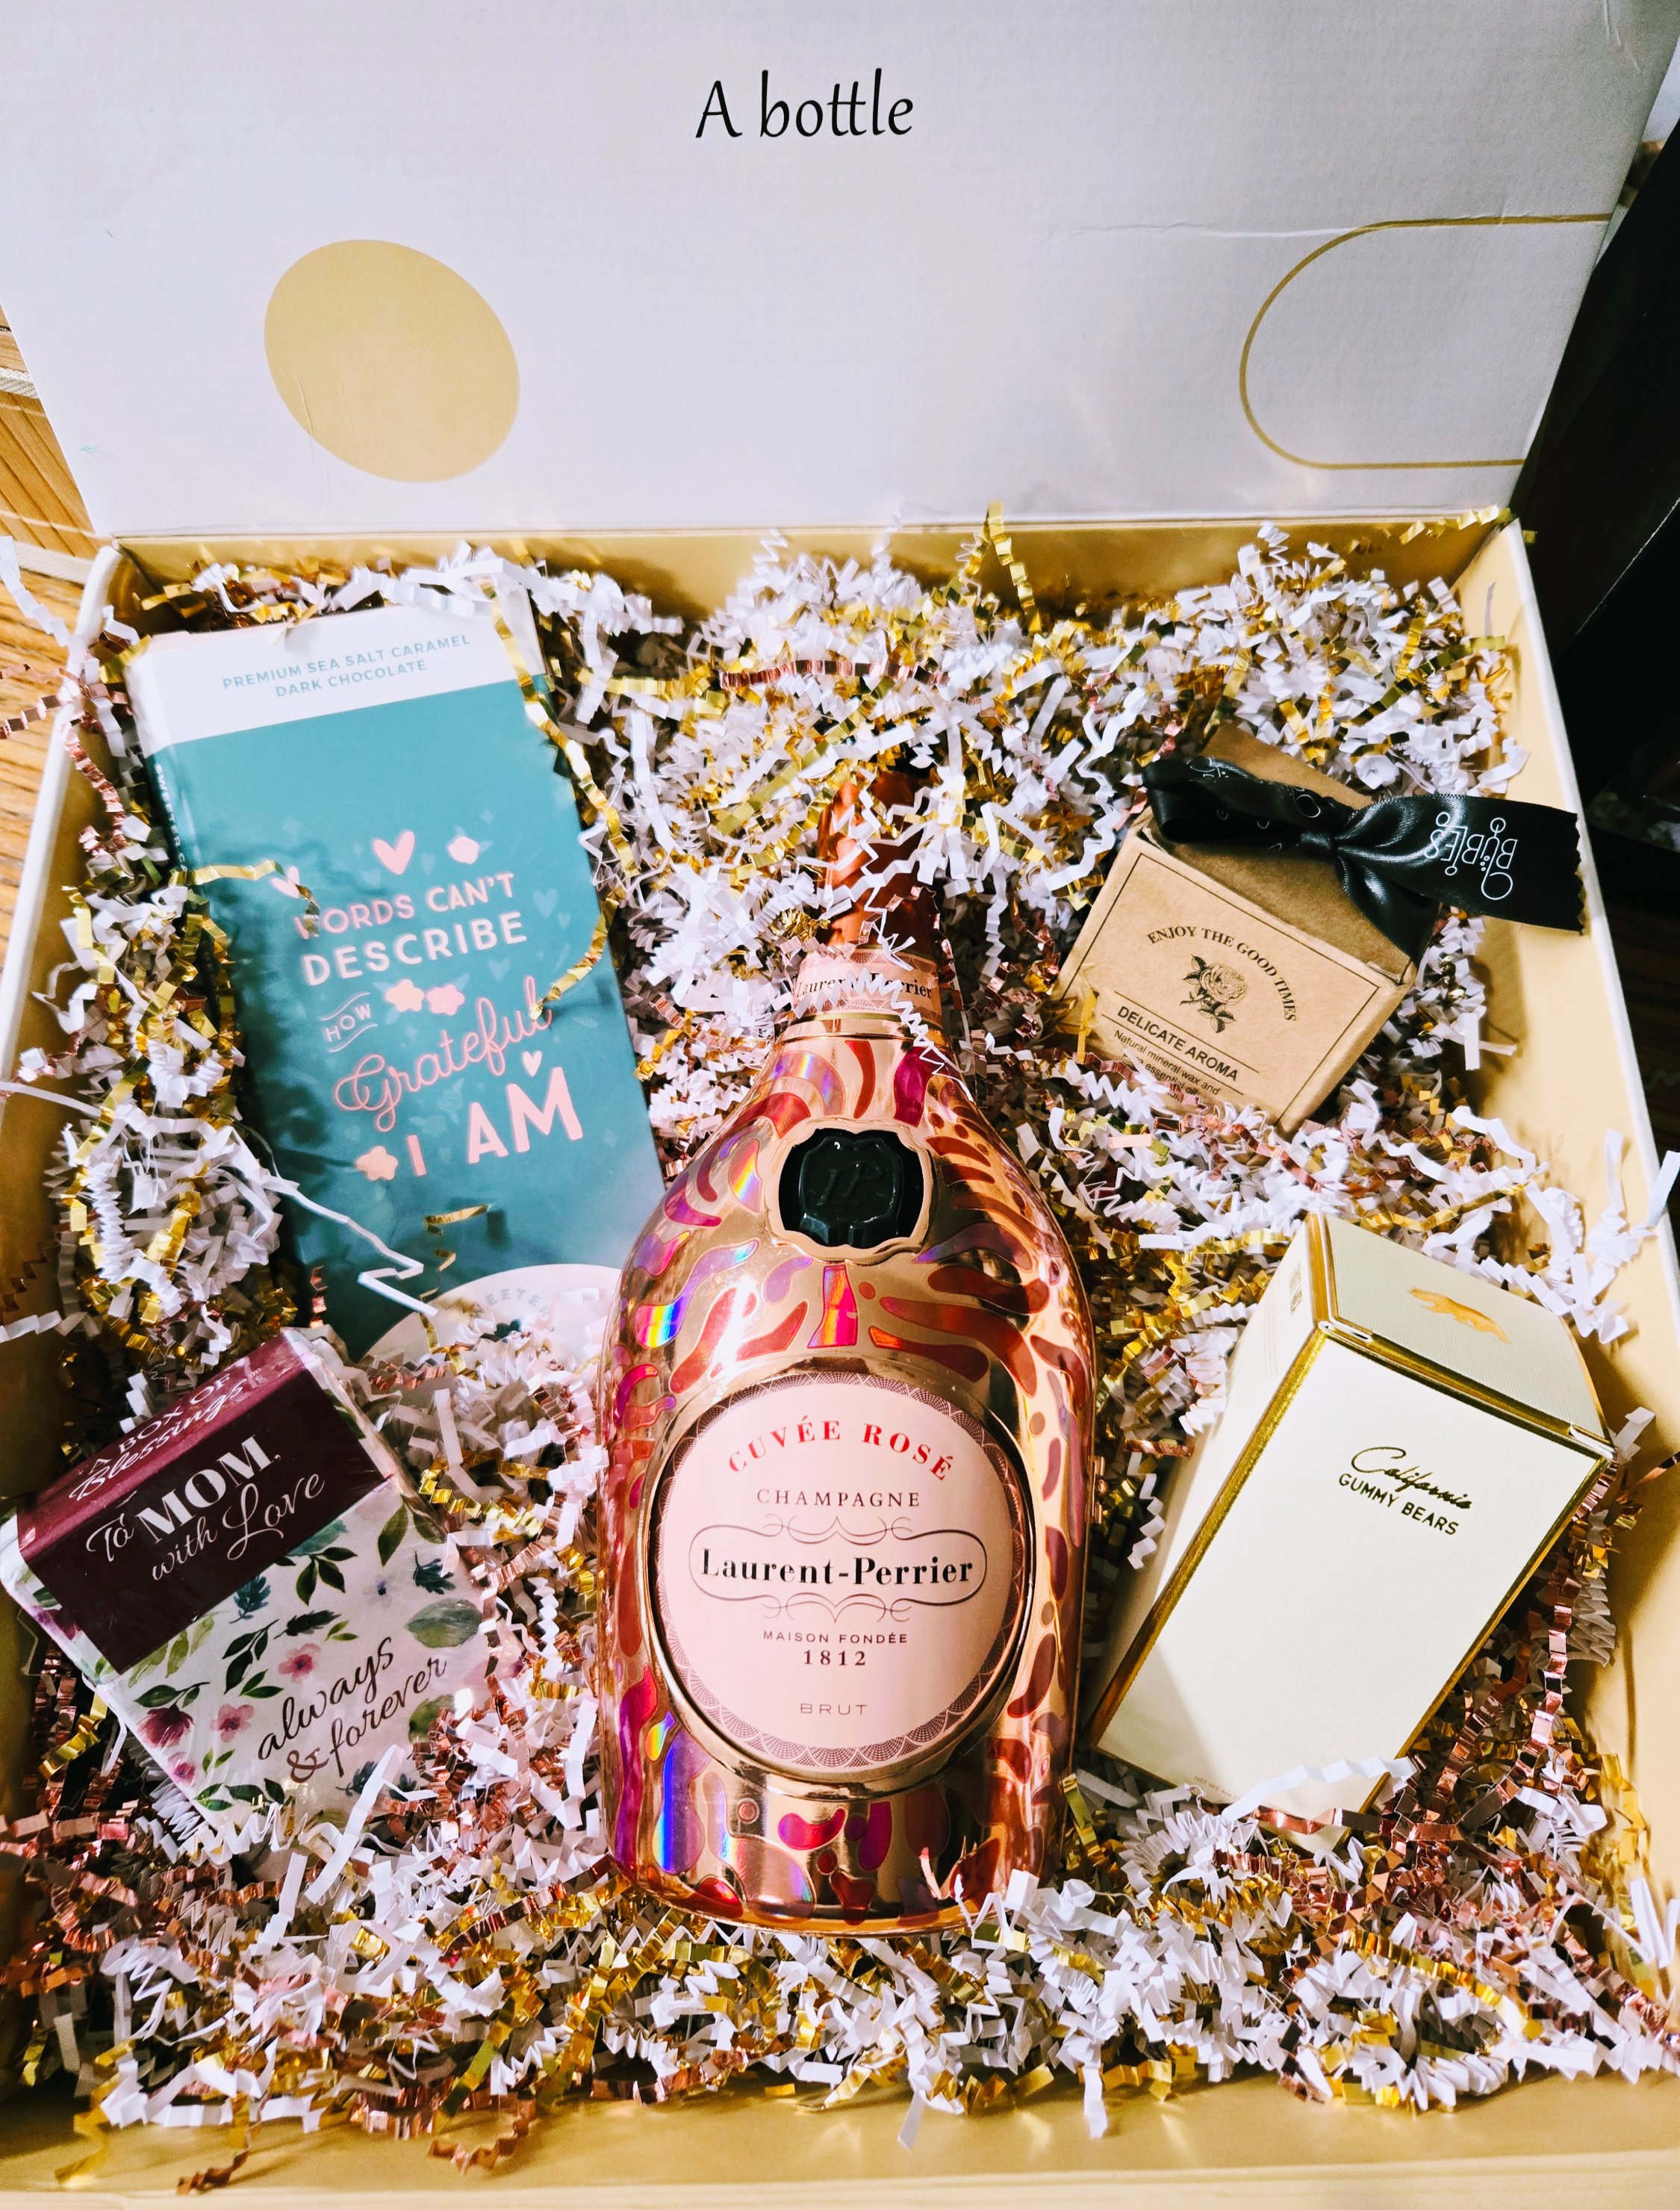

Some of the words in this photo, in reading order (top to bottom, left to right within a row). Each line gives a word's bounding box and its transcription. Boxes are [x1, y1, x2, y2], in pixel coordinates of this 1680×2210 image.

[696, 80, 743, 138] A
[760, 67, 914, 137] bottle
[222, 665, 302, 689] PREMIUM
[307, 657, 340, 674] SEA
[345, 649, 385, 667] SALT
[391, 634, 471, 657] CARAMEL
[275, 678, 323, 698] DARK
[328, 659, 427, 688] CHOCOLATE
[301, 910, 527, 987] DESCRIBE
[1146, 925, 1197, 944] ENJOY
[1201, 927, 1235, 948] THE
[1236, 941, 1278, 978] GOOD
[1274, 976, 1297, 1022] TIMES
[323, 1003, 372, 1043] HOW
[333, 975, 553, 1133] Grateful
[1117, 1005, 1186, 1052] DELICATE
[1184, 1046, 1239, 1082] AROMA
[1114, 1029, 1148, 1054] Natural
[1148, 1051, 1181, 1074] mineral
[1182, 1070, 1202, 1085] wax
[1201, 1081, 1221, 1096] and
[405, 1134, 427, 1177] I
[467, 1066, 584, 1164] AM
[118, 1405, 184, 1455] BOX
[189, 1373, 231, 1406] OF
[728, 1415, 841, 1473] CUVÉE
[860, 1422, 954, 1482] ROSÉ
[1351, 1446, 1473, 1509] California
[85, 1512, 136, 1562] To
[135, 1434, 282, 1544] MOM,
[152, 1517, 219, 1581] with
[223, 1472, 326, 1561] Love
[756, 1488, 921, 1508] CHAMPAGNE
[1338, 1472, 1400, 1507] GUMMY
[1400, 1501, 1460, 1536] BEARS
[700, 1547, 974, 1586] Laurent-Perrier
[762, 1630, 830, 1643] MAISON
[839, 1631, 908, 1644] FONDÉE
[803, 1649, 867, 1667] 1812
[258, 1636, 395, 1761] always
[285, 1748, 329, 1784] &
[329, 1655, 448, 1778] forever
[800, 1701, 868, 1716] BRUT
